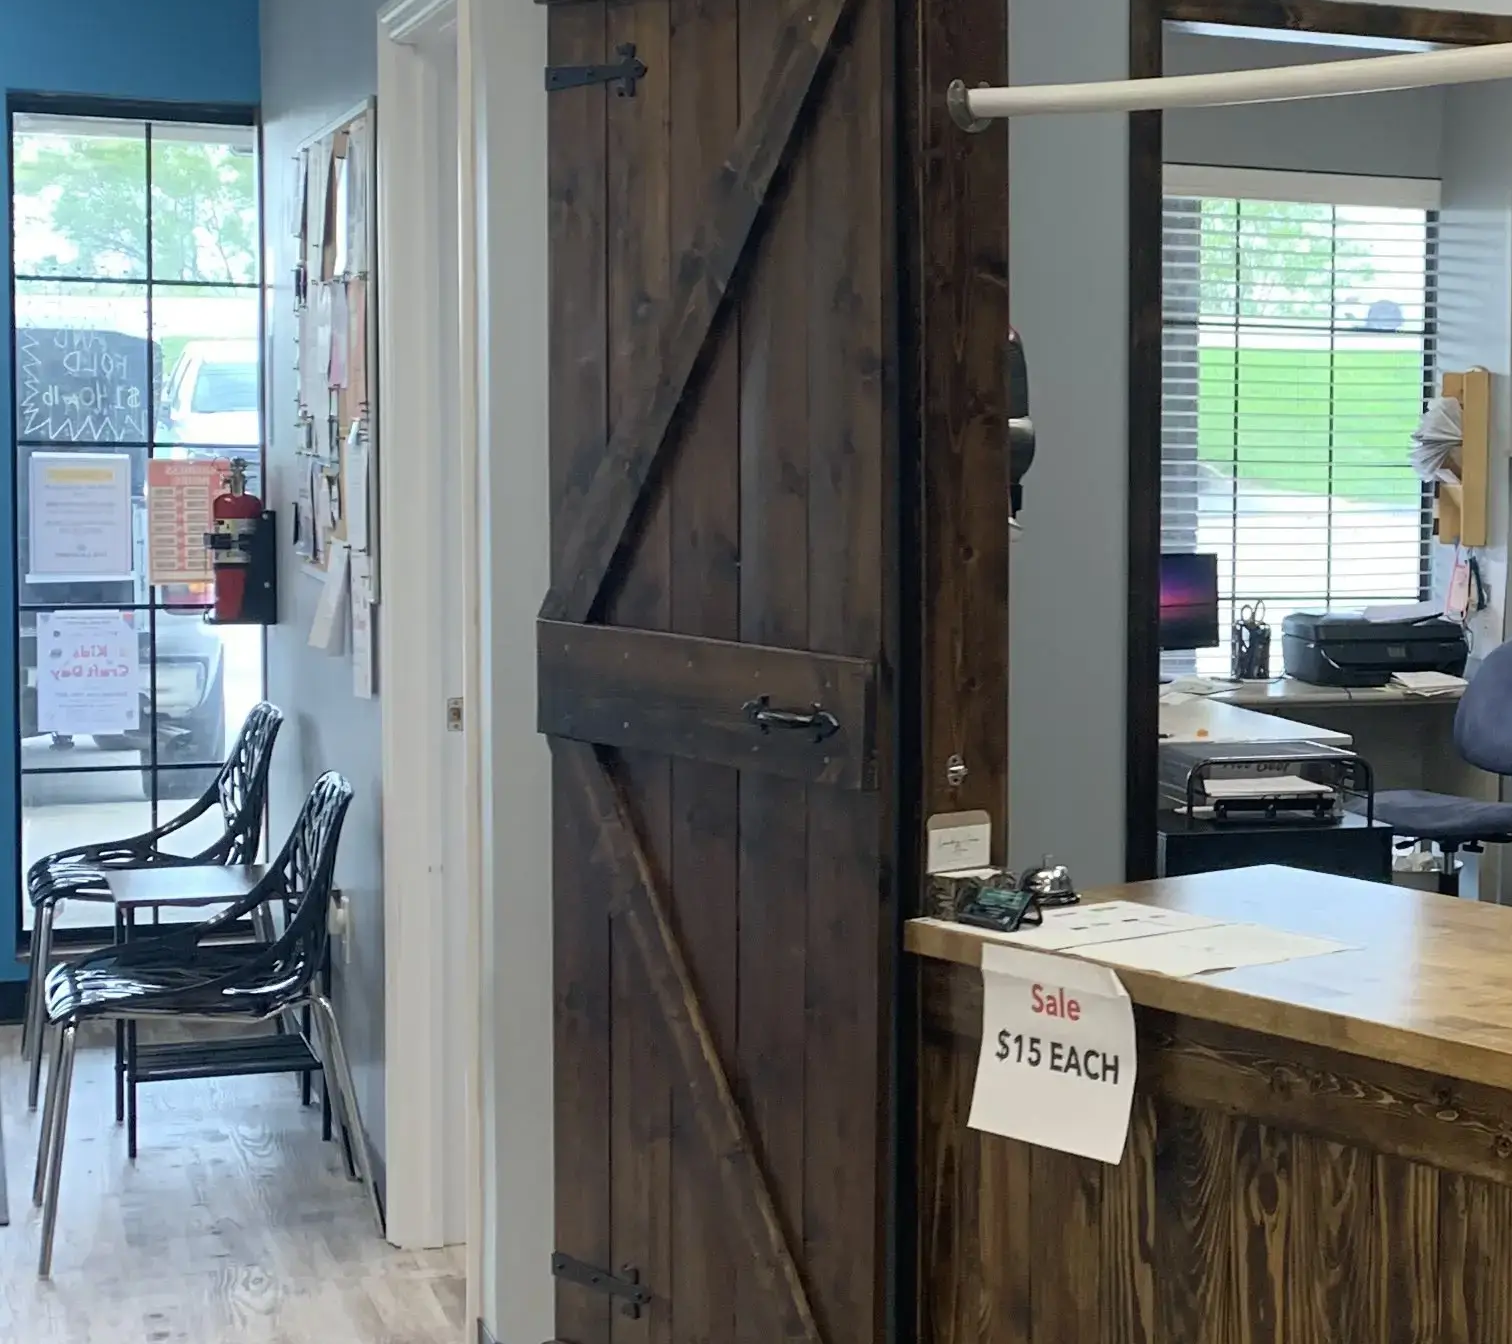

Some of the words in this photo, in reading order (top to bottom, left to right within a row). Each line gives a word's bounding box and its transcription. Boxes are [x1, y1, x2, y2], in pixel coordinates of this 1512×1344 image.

[1031, 983, 1081, 1021] Sale
[995, 1029, 1041, 1067] $15
[1049, 1042, 1119, 1085] EACH
